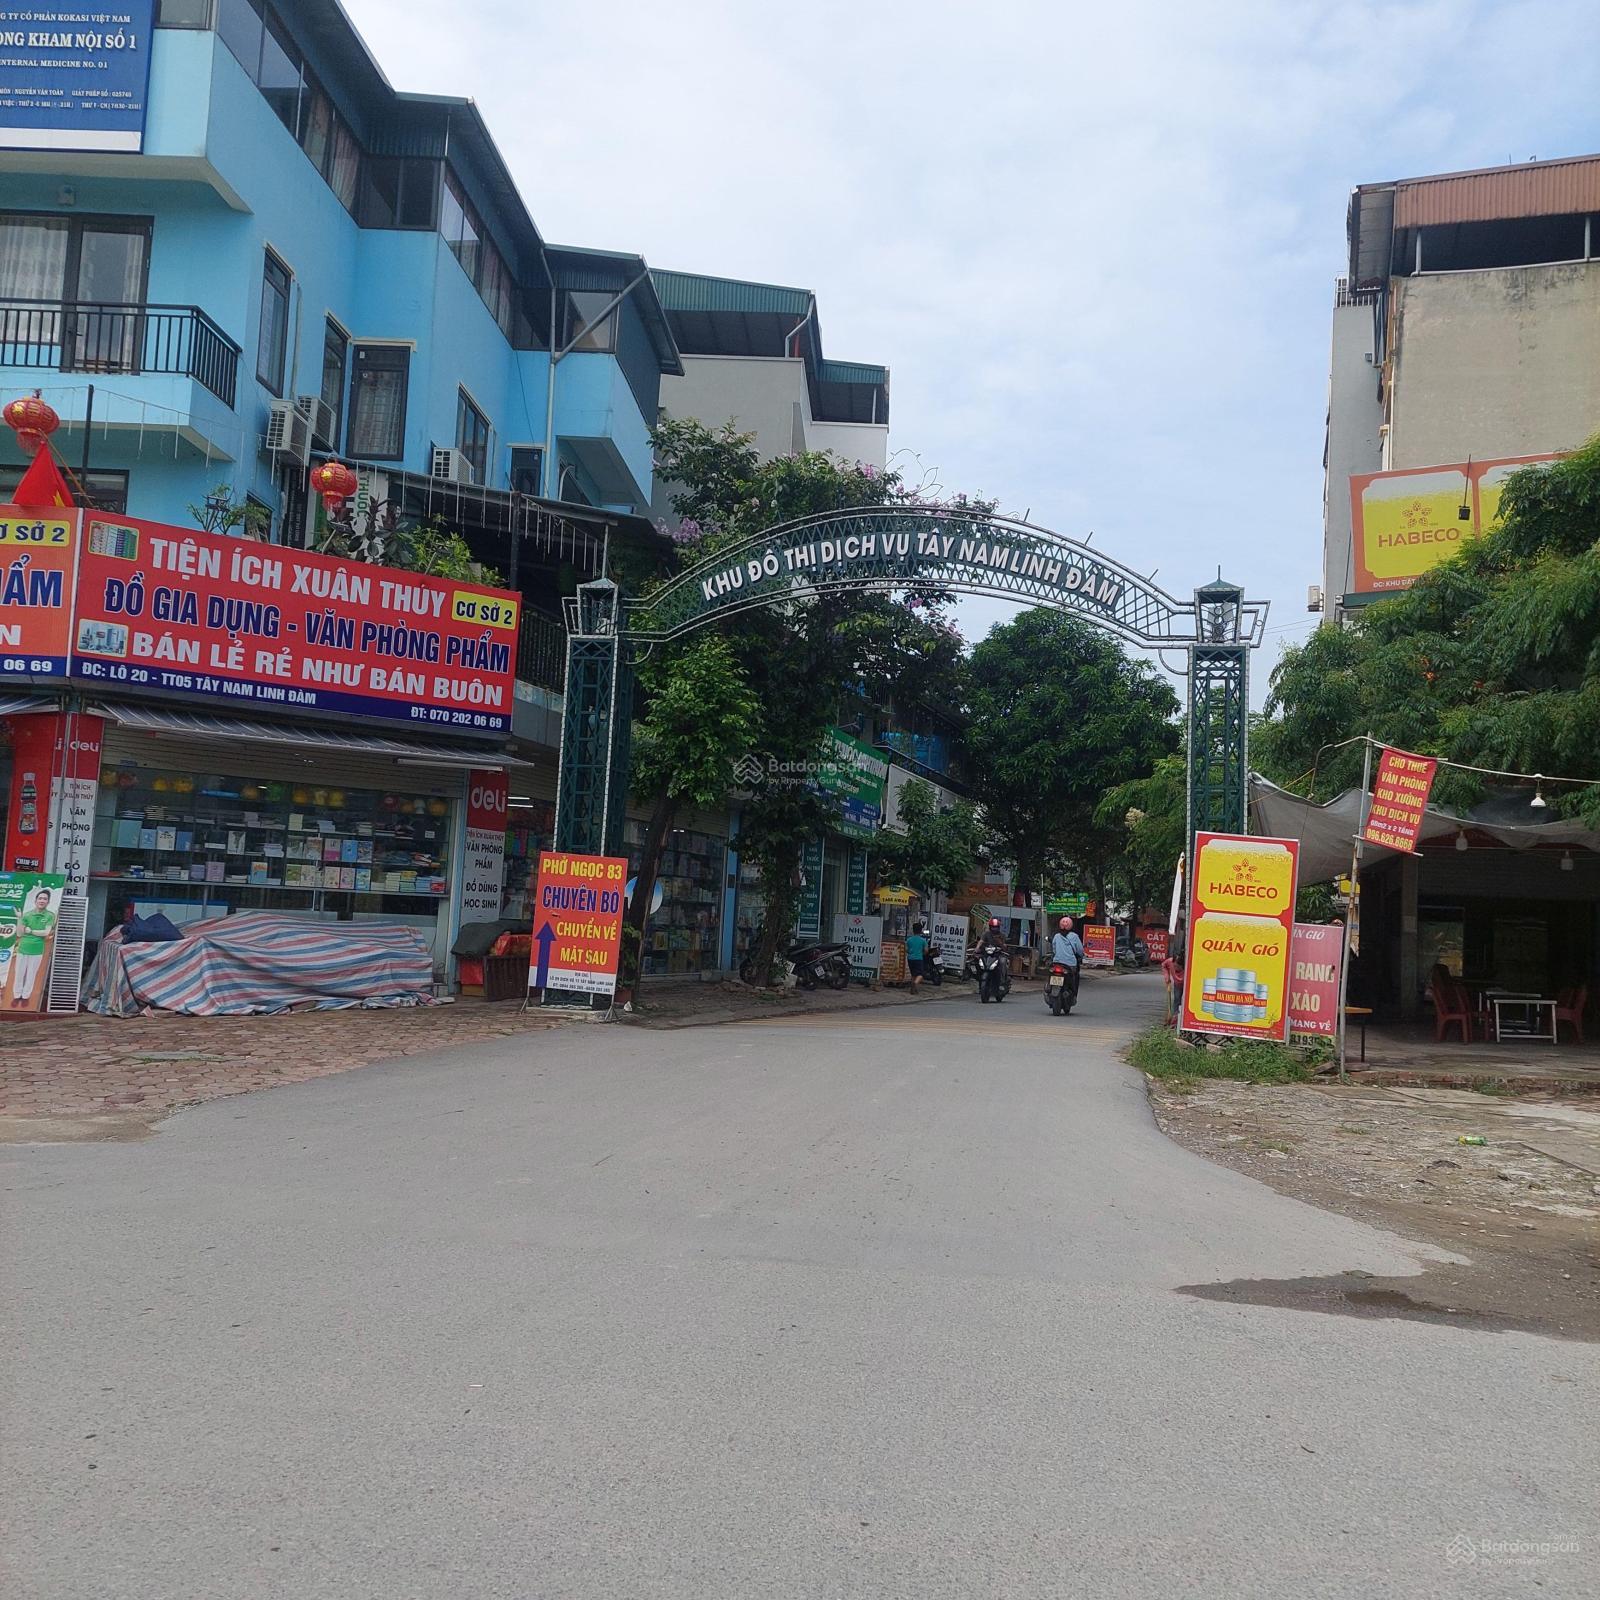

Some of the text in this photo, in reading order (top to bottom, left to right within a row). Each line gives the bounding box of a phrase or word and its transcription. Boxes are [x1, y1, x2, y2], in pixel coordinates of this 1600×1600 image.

[8, 12, 19, 20] TY
[57, 14, 89, 22] KOKASI
[91, 12, 110, 24] VIỆT
[112, 15, 131, 23] NAM
[75, 30, 102, 53] NỘI
[105, 27, 126, 49] SỐ
[129, 34, 137, 49] 1
[40, 60, 81, 68] MEDICINE
[98, 61, 108, 69] 01
[15, 521, 46, 542] SỞ
[52, 526, 65, 542] 2
[1378, 527, 1460, 548] HABECO
[150, 538, 221, 581] TIỆN
[231, 547, 283, 590] ÍCH
[290, 567, 371, 606] XUÂN
[702, 528, 1120, 606] KHU ĐÔ THỊ DỊCH VỤ TÂY NAM LINH ĐÀM
[104, 571, 146, 617] ĐỒ
[152, 586, 199, 626] GIA
[206, 595, 281, 640] DỤNG
[305, 608, 356, 651] VĂN
[361, 620, 441, 664] PHÒNG
[445, 629, 511, 674] PHẨM
[456, 600, 514, 625] CƠ SỞ 2
[3, 658, 53, 672] 06 69
[132, 632, 504, 707] BÁN LẺ RẺ NHƯ BÁN BUÔN
[82, 662, 106, 677] ĐC:
[109, 664, 126, 679] LÔ
[130, 669, 148, 683] 20
[161, 672, 192, 688] TT05
[196, 676, 220, 692] TÂY
[222, 681, 253, 697] NAM
[256, 685, 285, 701] LINH
[288, 689, 317, 706] ĐÀM
[411, 706, 503, 729] ĐT: 070 202 06 69
[69, 740, 99, 752] deli
[1388, 756, 1406, 771] CHO
[1381, 771, 1428, 792] VĂN PHÒNG
[471, 786, 507, 813] deli
[1376, 788, 1423, 808] KHO XƯỞNG
[1371, 804, 1421, 827] KHU DỊCH VỤ
[466, 840, 480, 852] VĂN
[542, 855, 623, 881] PHỞ NGỌC 83
[543, 884, 620, 914] CHUYÊN BÒ
[1209, 883, 1278, 899] HABECO
[464, 898, 498, 911] HỌC SINH
[556, 917, 617, 942] CHUYỂN VỀ
[844, 935, 870, 943] THUỐC
[935, 924, 947, 936] GỘI
[1305, 929, 1326, 940] GIÓ
[560, 945, 608, 966] MẶT SAU
[857, 945, 876, 954] THƯ
[1201, 938, 1280, 957] QUÁN GIÓ
[1295, 961, 1335, 983] RANG
[1291, 990, 1320, 1013] XÀO
